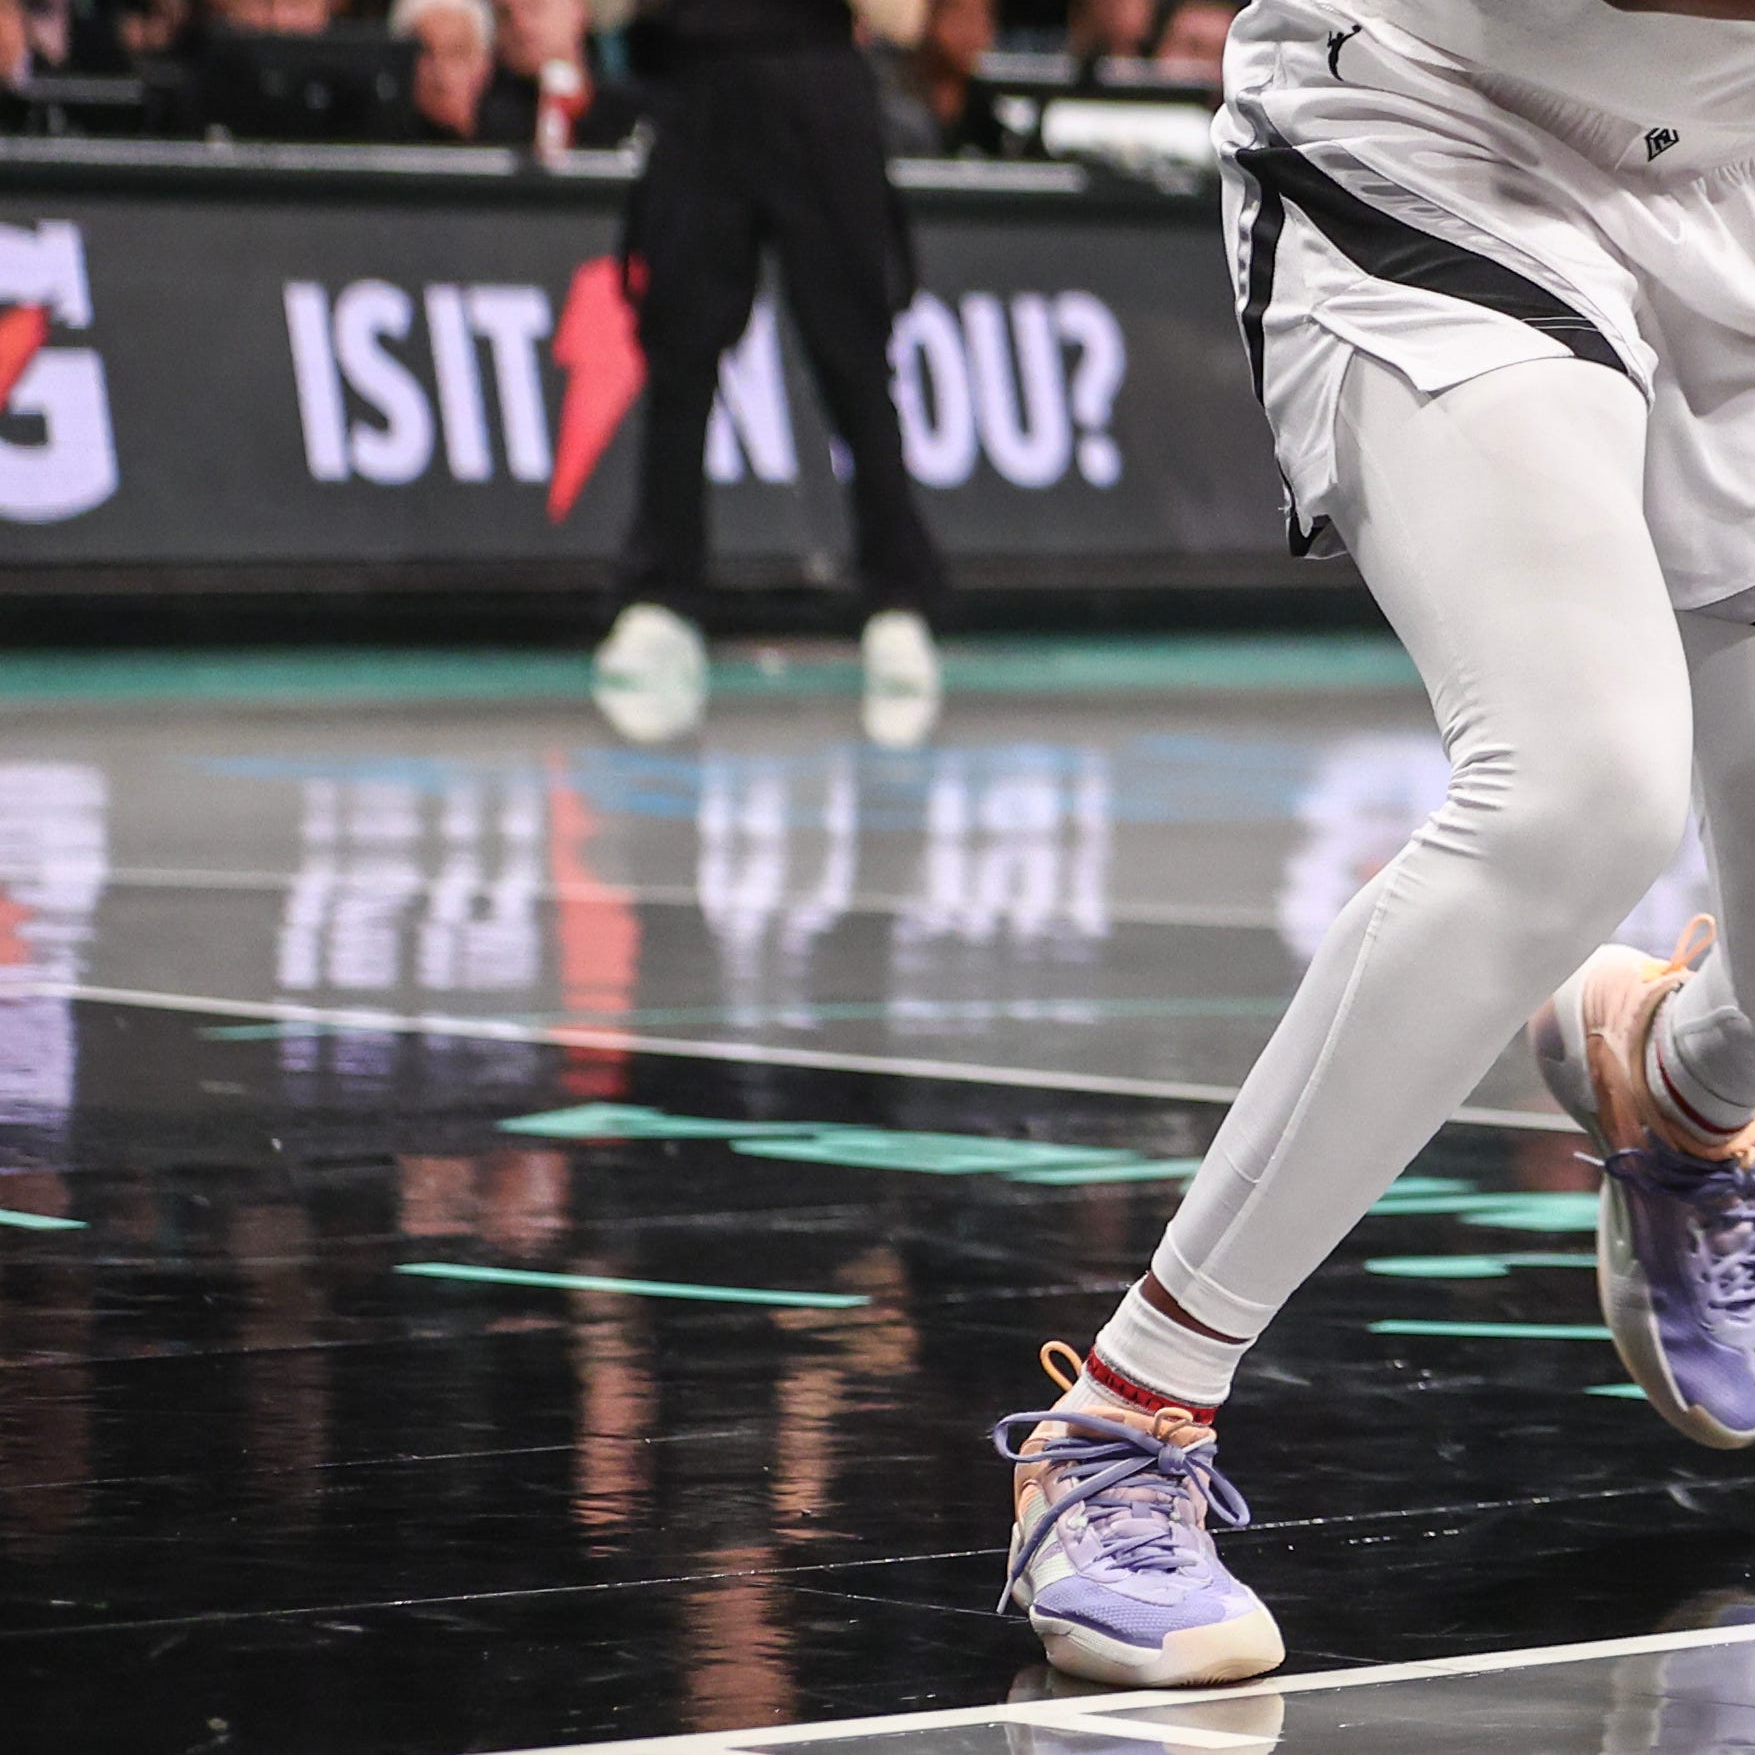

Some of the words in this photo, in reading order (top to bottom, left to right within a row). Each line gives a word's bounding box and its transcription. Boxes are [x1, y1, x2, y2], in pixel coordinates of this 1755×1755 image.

[283, 278, 435, 485] IS
[423, 281, 557, 484] IT
[828, 289, 1127, 489] OU?
